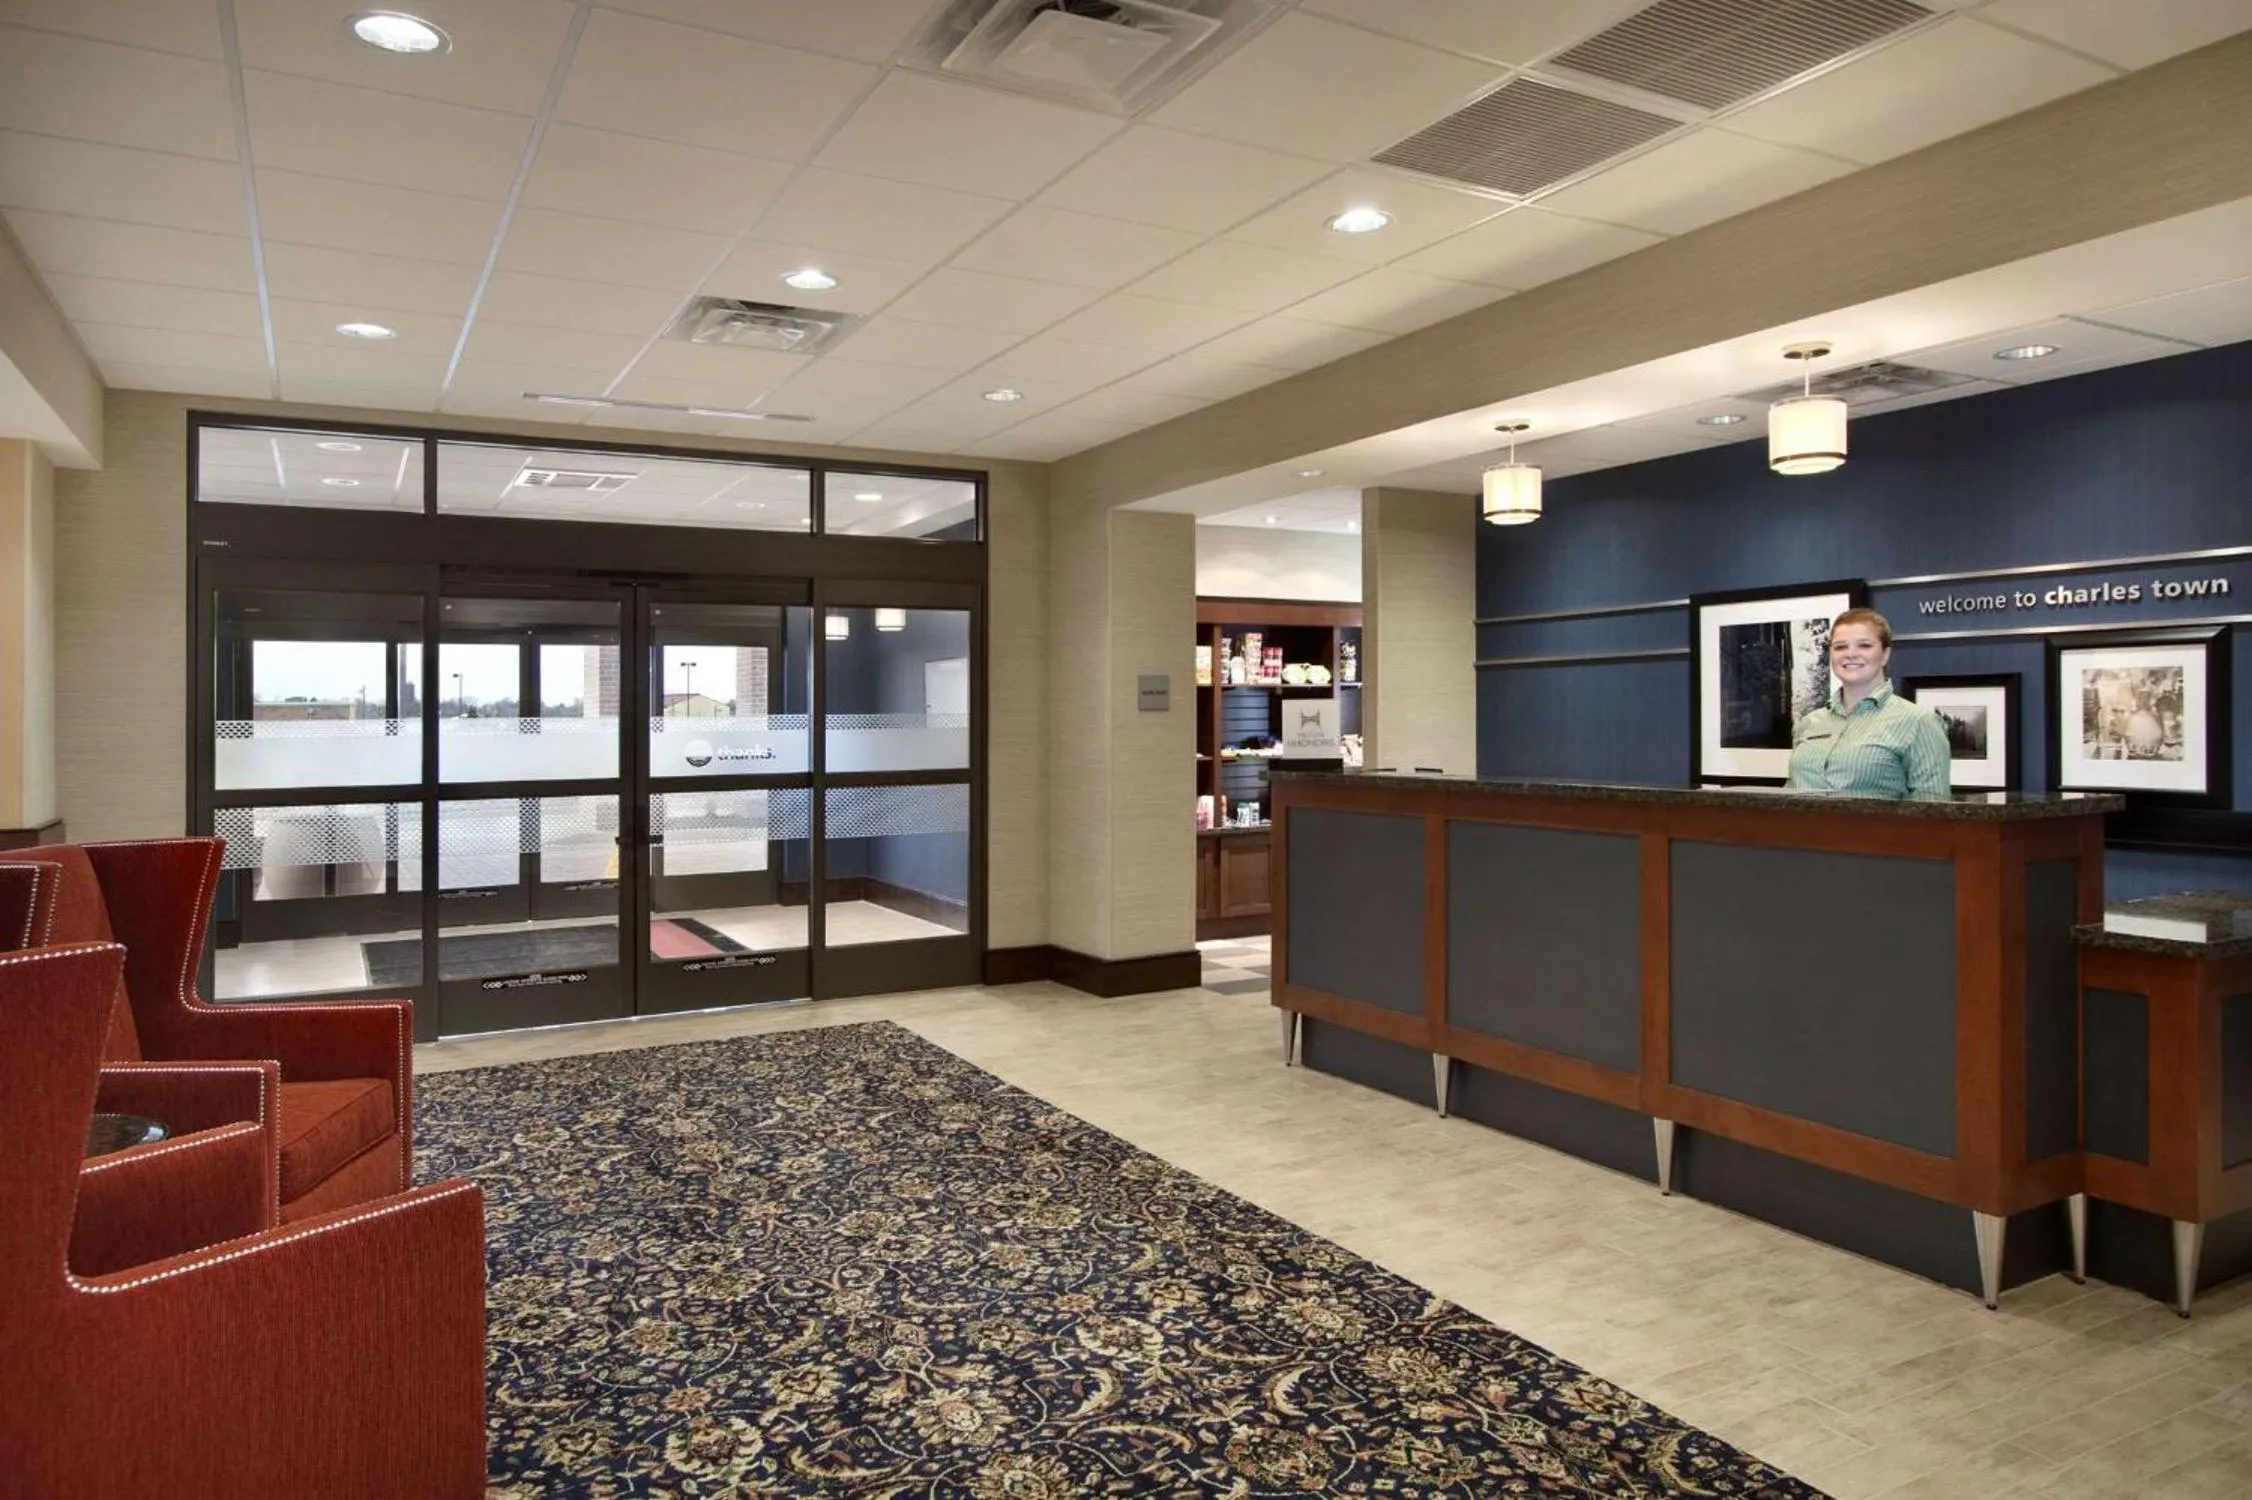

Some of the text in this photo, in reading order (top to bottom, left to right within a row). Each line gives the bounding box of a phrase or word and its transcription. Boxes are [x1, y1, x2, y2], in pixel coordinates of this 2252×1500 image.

[1920, 577, 2228, 614] welcome to charles town
